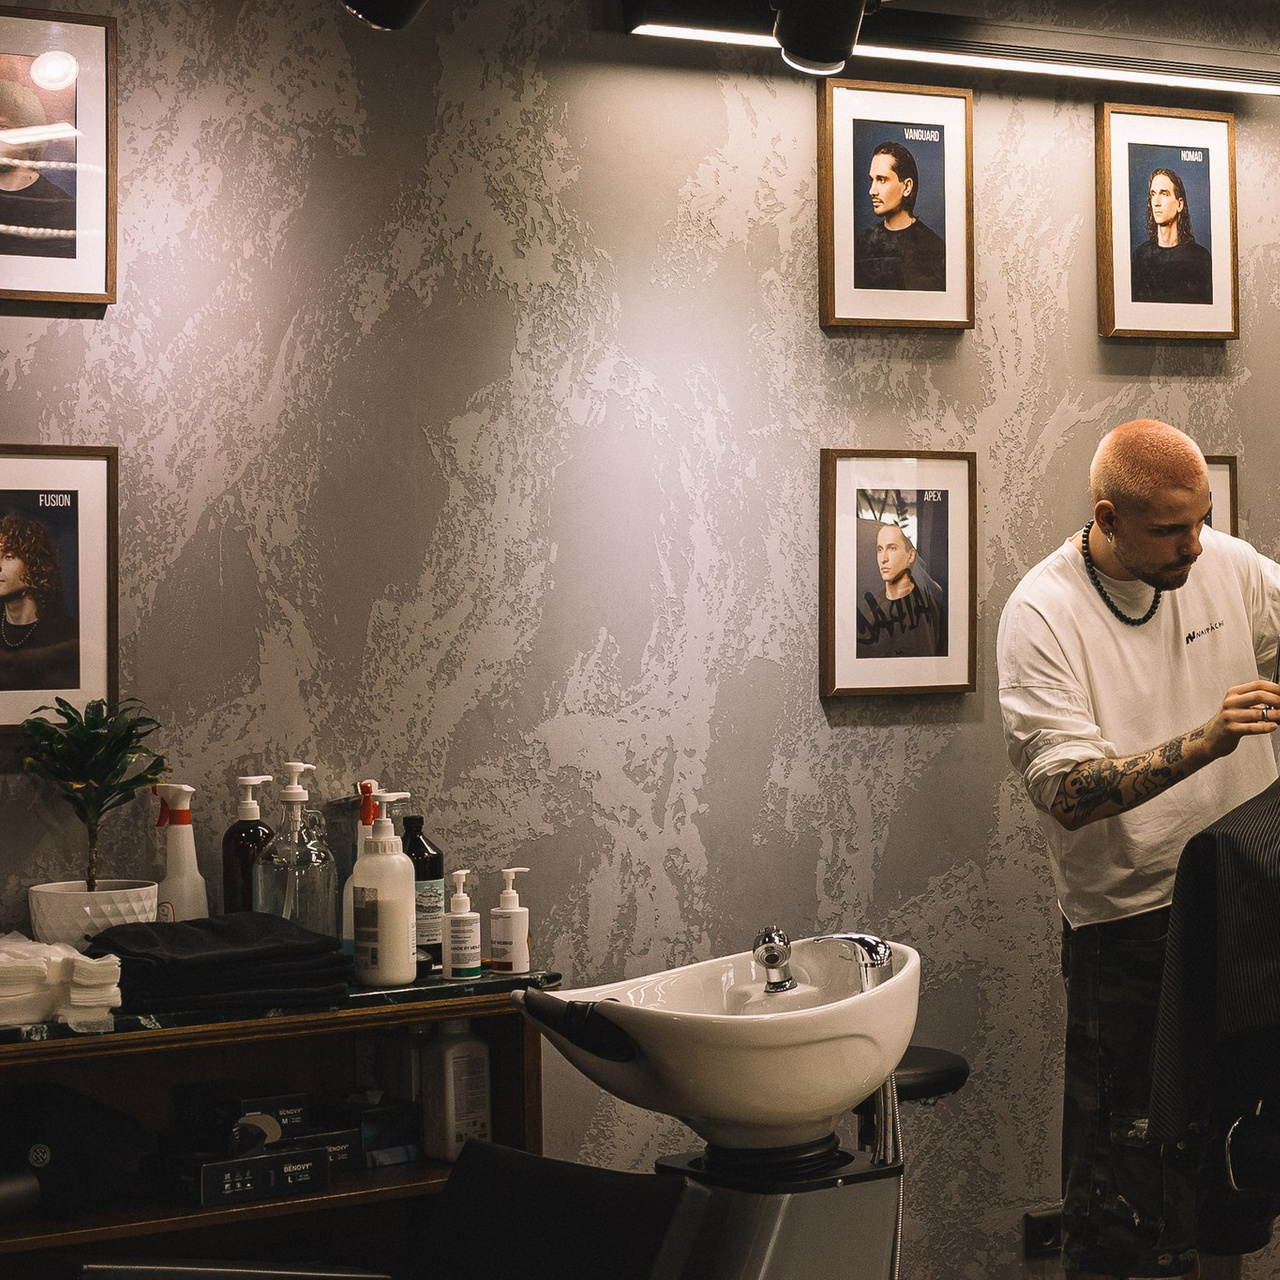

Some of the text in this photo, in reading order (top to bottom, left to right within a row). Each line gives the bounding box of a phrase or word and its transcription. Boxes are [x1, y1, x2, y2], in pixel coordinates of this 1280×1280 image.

[904, 128, 940, 142] VANGUARD
[1181, 150, 1203, 163] NOMAD
[39, 494, 71, 507] FUSION
[923, 491, 942, 502] APEX
